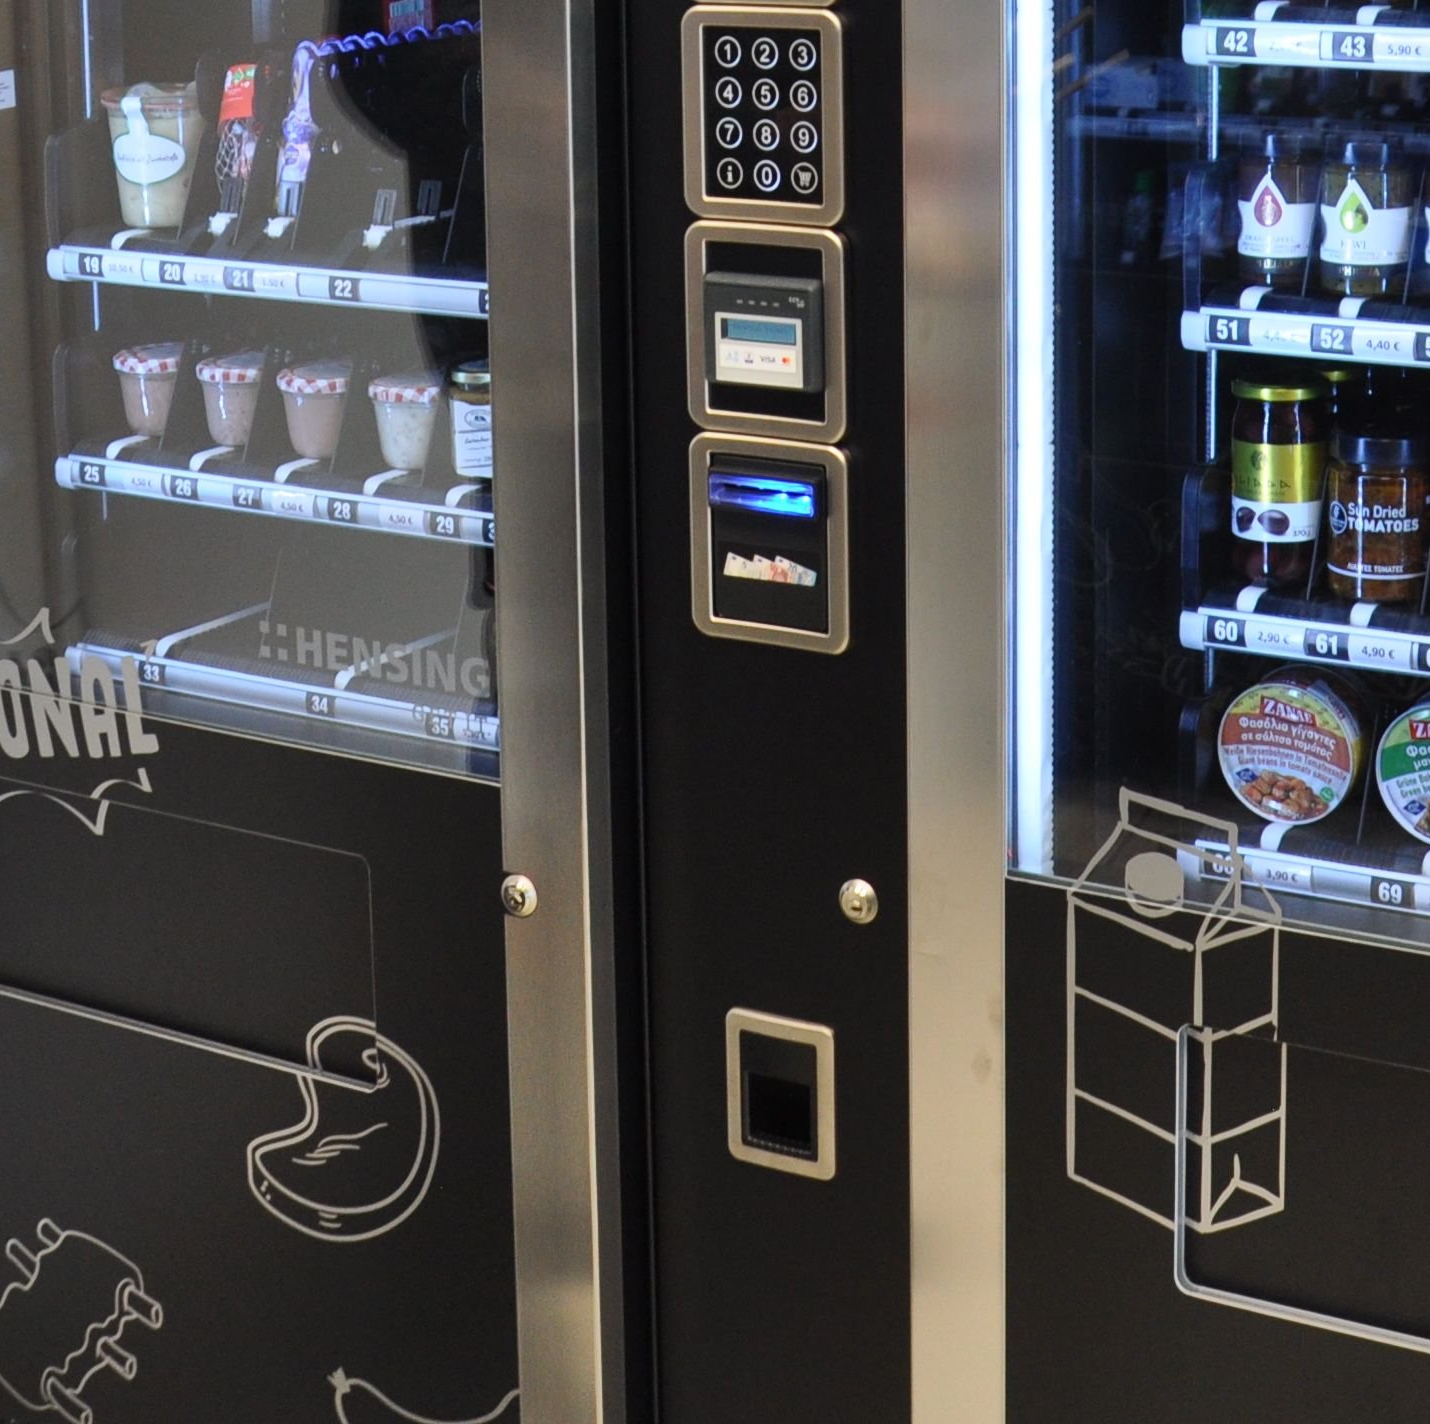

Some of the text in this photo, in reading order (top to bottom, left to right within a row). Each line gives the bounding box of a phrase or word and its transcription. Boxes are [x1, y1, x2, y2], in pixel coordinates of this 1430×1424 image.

[1223, 29, 1248, 53] 42
[1340, 35, 1366, 58] 43
[723, 43, 732, 61] 1
[759, 44, 771, 63] 2
[797, 46, 809, 65] 3
[722, 84, 734, 101] 4
[760, 86, 771, 104] 5
[798, 87, 809, 106] 6
[724, 124, 734, 141] 7
[761, 126, 772, 144] 8
[798, 128, 810, 147] 9
[761, 167, 773, 185] 0
[83, 256, 100, 274] 19
[162, 263, 181, 282] 20
[334, 278, 353, 297] 22
[1215, 321, 1239, 342] 51
[84, 464, 100, 481] 25
[333, 501, 351, 520] 28
[1348, 502, 1407, 519] Sun Dried
[436, 515, 454, 535] 29
[1348, 517, 1419, 533] TOMATOES
[1214, 621, 1238, 641] 60
[1316, 634, 1338, 655] 61
[1362, 644, 1385, 658] 4,90
[296, 626, 492, 699] HENSING
[311, 694, 329, 714] 34
[1263, 697, 1313, 724] ZANAE
[1239, 717, 1337, 751] Φασόλια γίγαντες
[1378, 881, 1403, 904] 69
